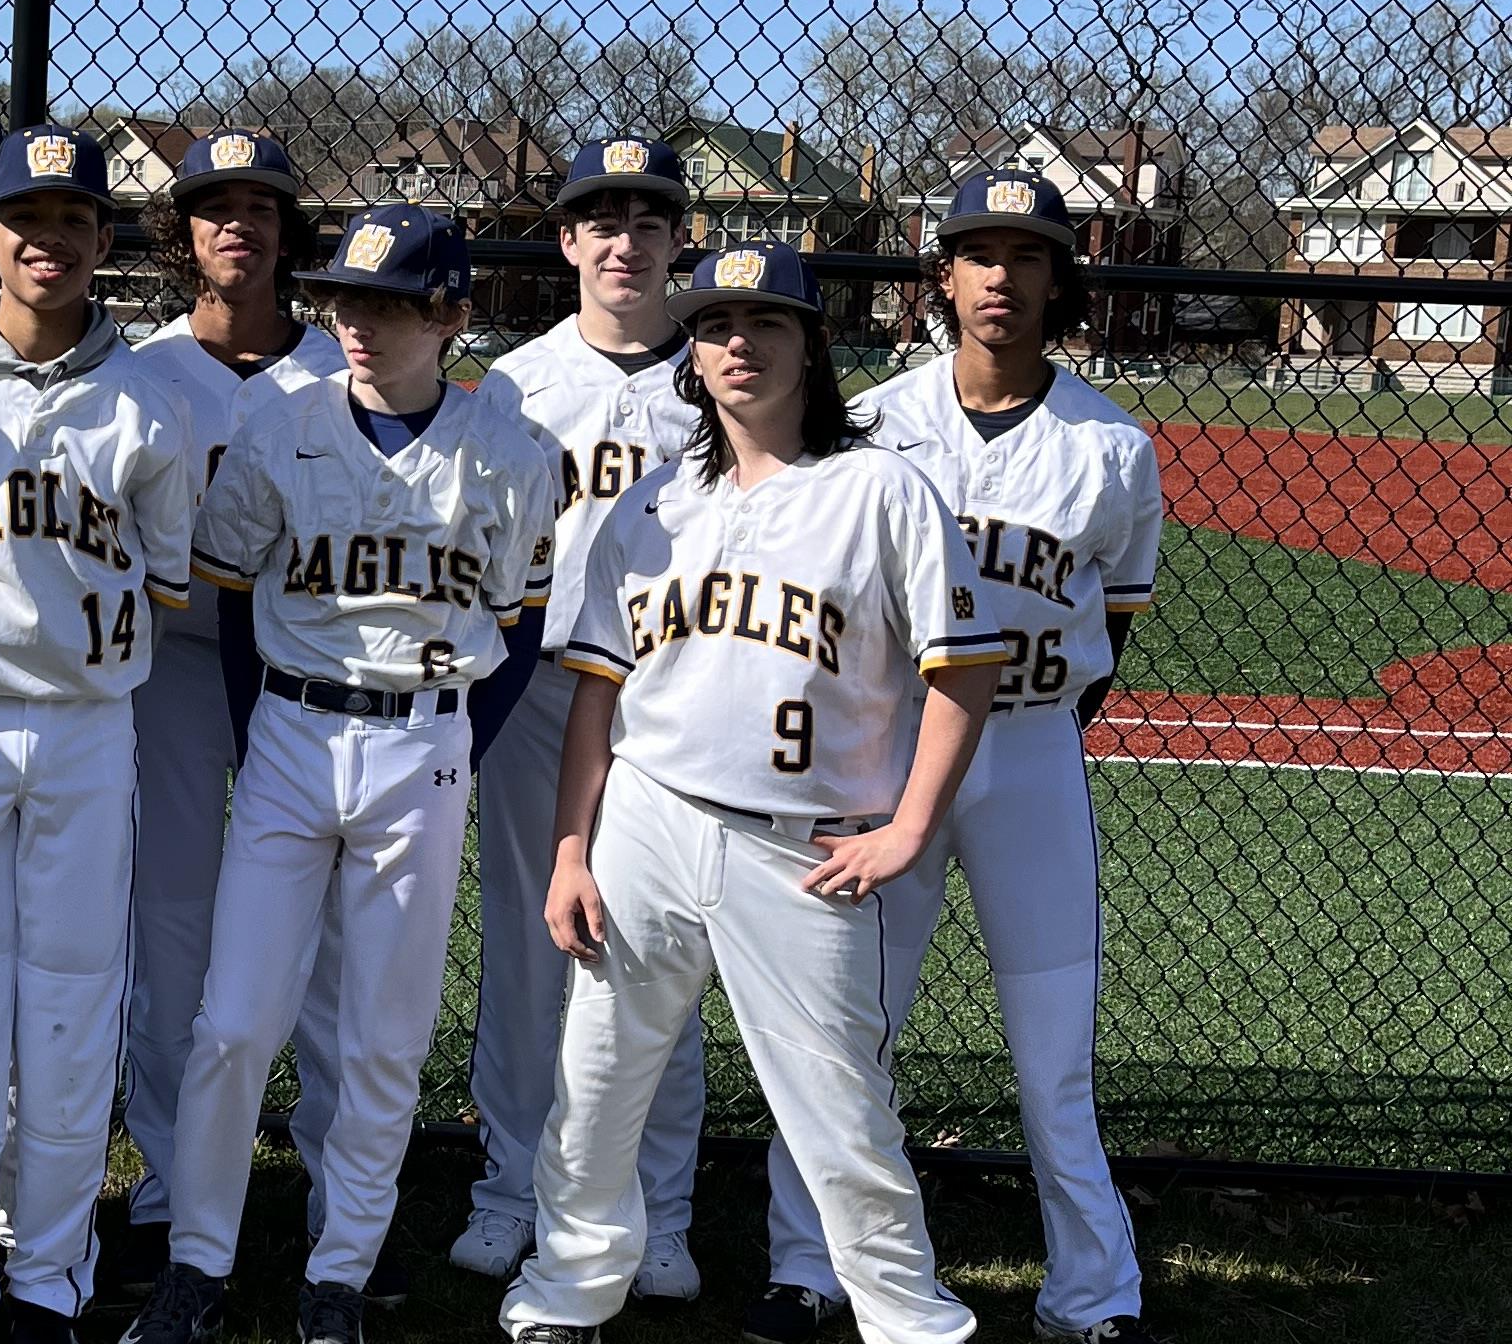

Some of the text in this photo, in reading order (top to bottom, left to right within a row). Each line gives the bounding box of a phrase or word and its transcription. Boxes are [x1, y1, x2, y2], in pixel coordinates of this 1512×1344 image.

[80, 589, 136, 667] 14
[626, 570, 846, 678] EAGLES
[995, 629, 1069, 696] 26
[770, 697, 813, 775] 9
